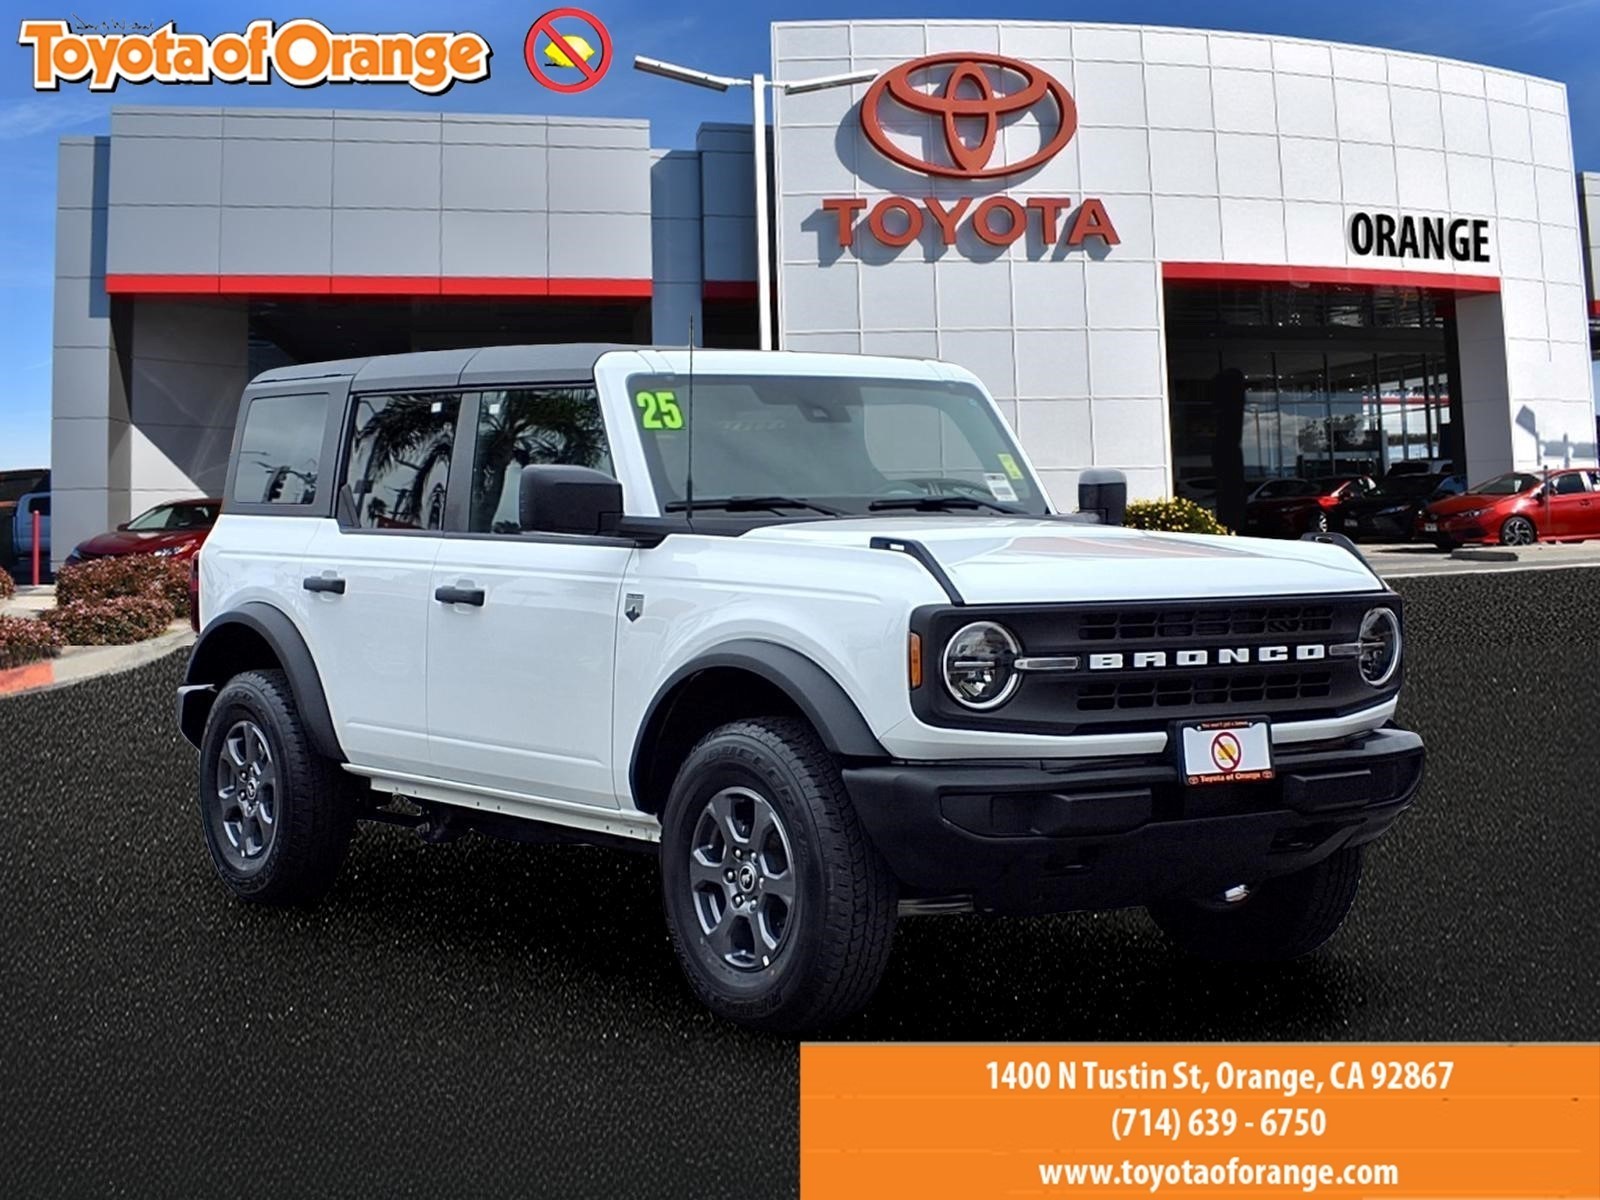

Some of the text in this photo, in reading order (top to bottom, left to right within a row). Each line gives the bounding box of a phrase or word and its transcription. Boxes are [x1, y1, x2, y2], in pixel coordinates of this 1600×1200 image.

[823, 196, 1121, 247] TOYOTA
[1350, 212, 1490, 262] ORANGE
[636, 390, 683, 430] 25
[1089, 643, 1325, 669] BRONCO
